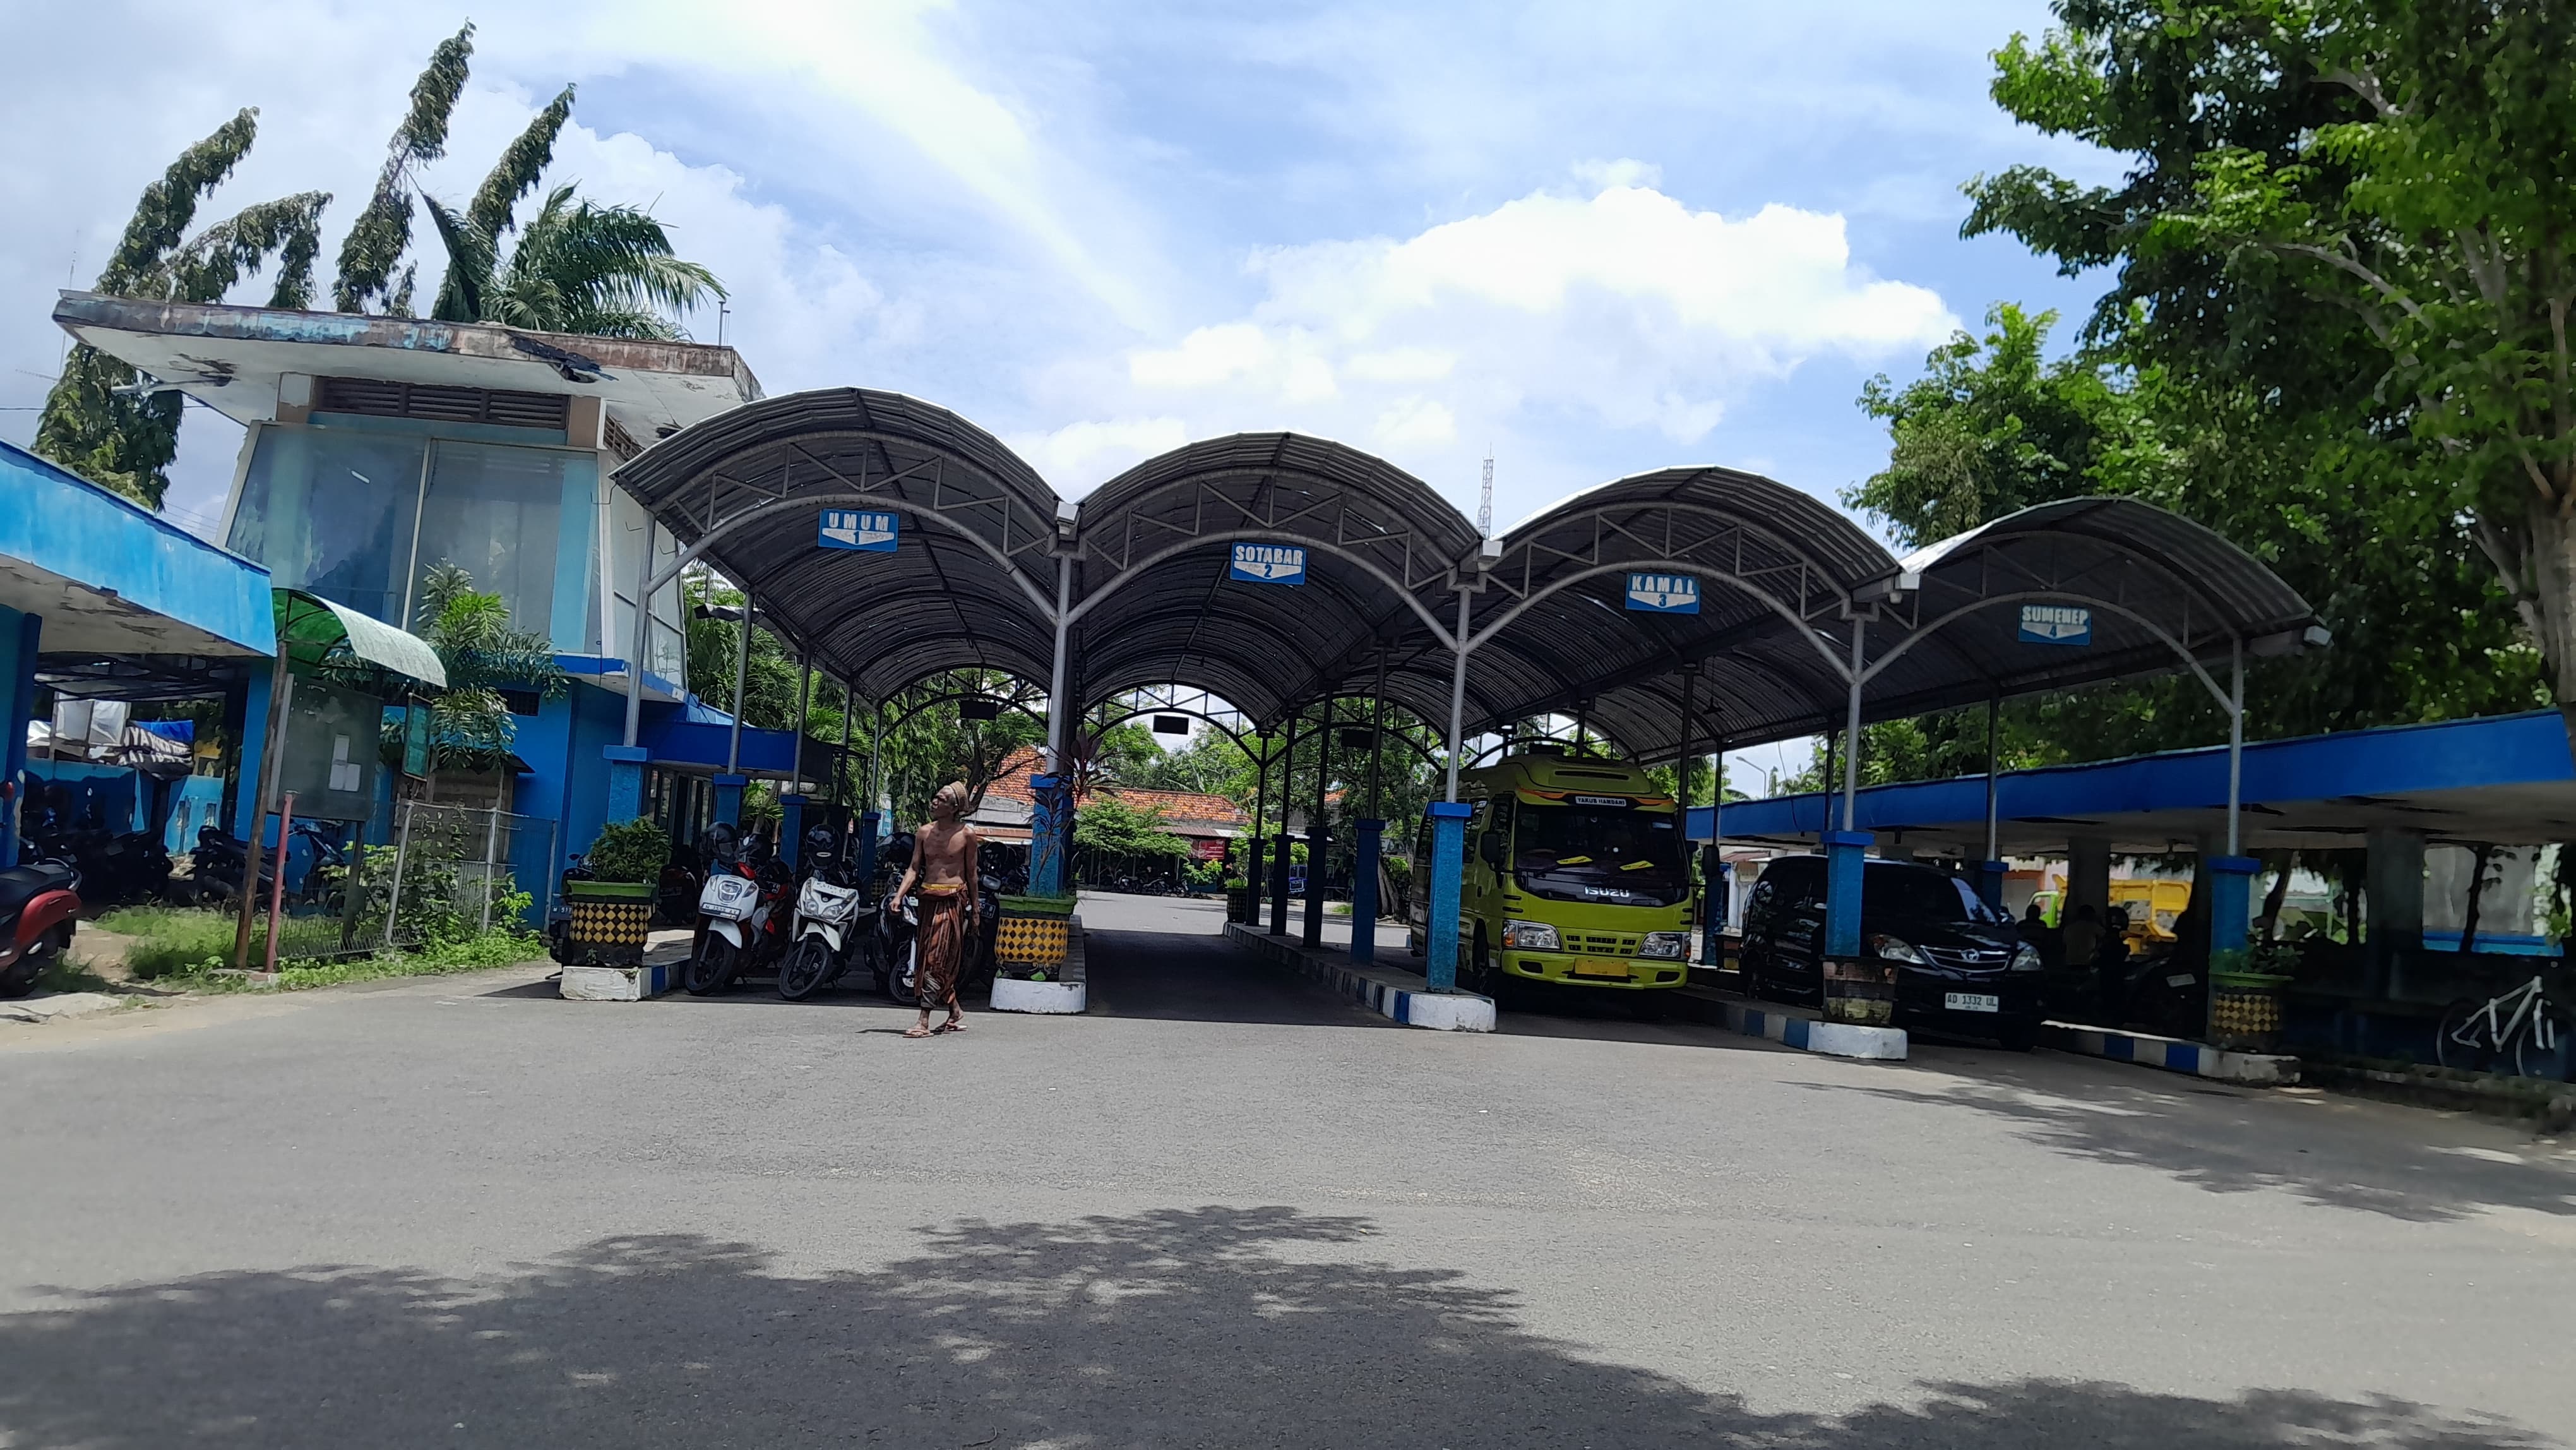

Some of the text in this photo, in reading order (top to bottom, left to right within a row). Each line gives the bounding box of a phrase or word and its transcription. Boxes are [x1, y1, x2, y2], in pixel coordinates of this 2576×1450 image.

[828, 512, 889, 531] UMUM
[854, 530, 859, 544] 1
[1235, 545, 1303, 565] SOTABAR
[1263, 564, 1272, 578] 2
[1631, 575, 1694, 594] KAMAL
[1658, 594, 1667, 607] 3
[2022, 605, 2089, 625] SUMENEP
[2049, 625, 2057, 637] 4
[1585, 886, 1630, 897] ISUZU
[1947, 994, 1958, 1004] AD
